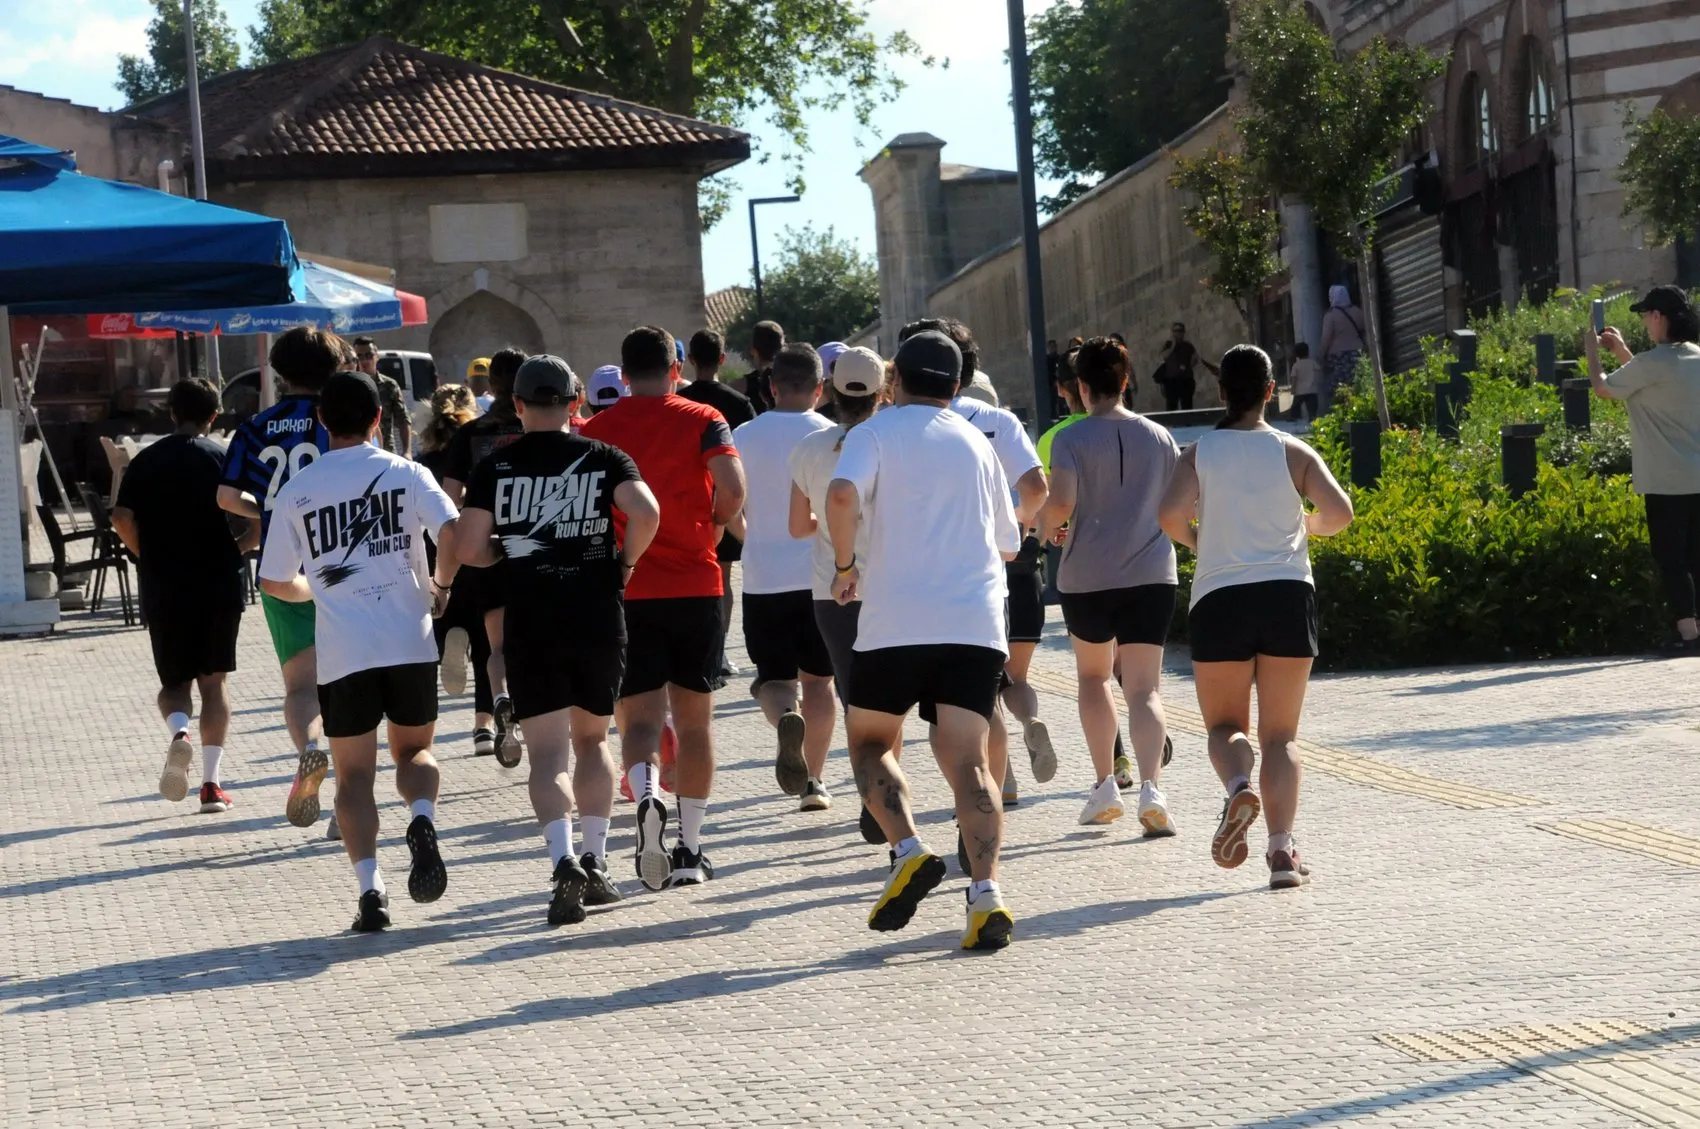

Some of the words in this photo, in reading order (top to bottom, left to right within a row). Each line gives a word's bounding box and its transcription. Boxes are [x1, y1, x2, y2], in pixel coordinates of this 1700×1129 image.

[267, 418, 312, 434] FURKAN
[555, 521, 580, 538] RUN
[582, 518, 608, 535] CLUB
[368, 538, 391, 557] RUN
[393, 535, 411, 551] CLUB
